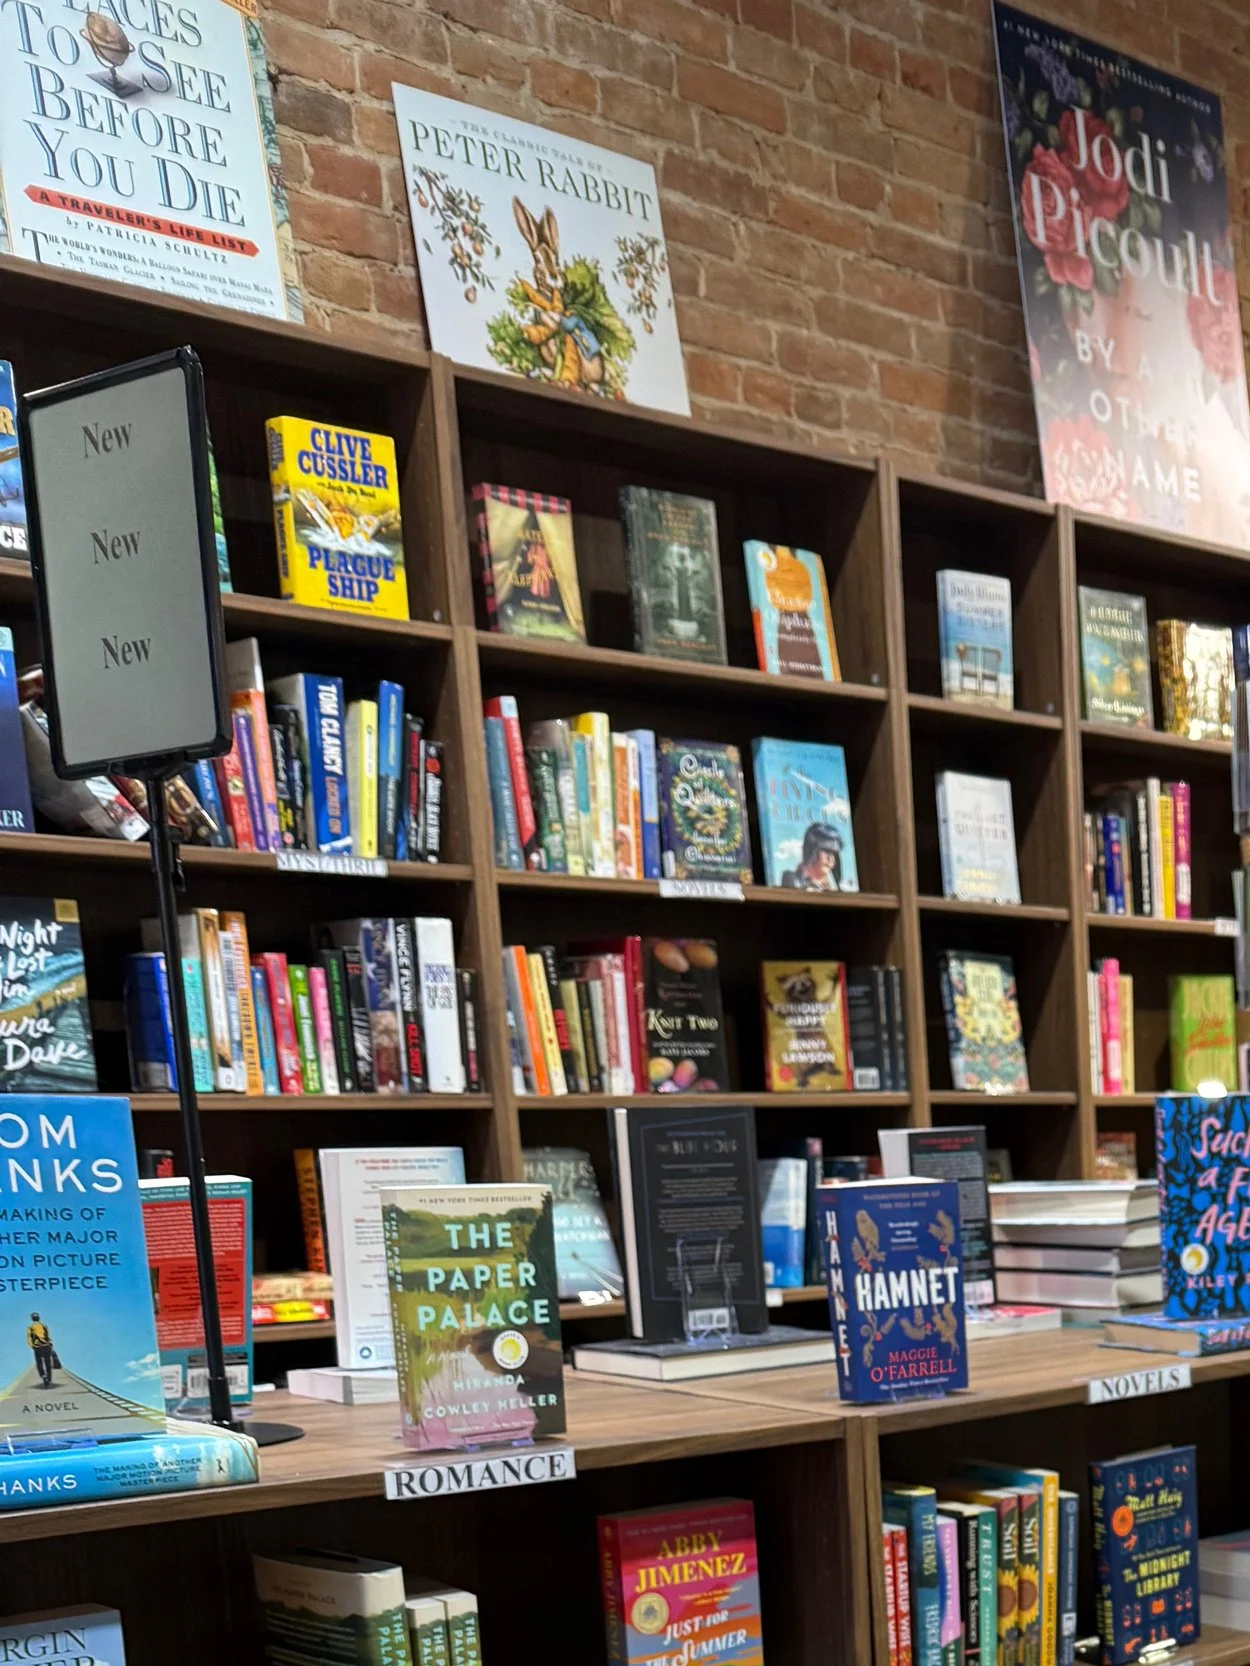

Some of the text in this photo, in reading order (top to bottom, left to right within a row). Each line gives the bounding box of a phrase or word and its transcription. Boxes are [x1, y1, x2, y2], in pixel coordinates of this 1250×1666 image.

[1, 0, 231, 113] TO SEE
[24, 61, 227, 167] BEFORE
[409, 119, 652, 222] PETER RABBIT
[1070, 104, 1172, 203] Jodi
[24, 119, 245, 227] YOU DIE
[39, 190, 247, 251] A TRAVELER'S LIFE LIST
[67, 217, 227, 264] by PATRICIA SCHULTZ
[1027, 171, 1224, 306] Picoult
[81, 421, 133, 459] New
[310, 428, 372, 462] CLIVE
[298, 450, 389, 490] CUSSLER
[92, 530, 141, 565] New
[307, 545, 395, 582] PLAGUE
[328, 573, 379, 602] SHIP
[101, 636, 151, 669] New
[0, 918, 63, 956] Night
[7, 949, 53, 981] Lost
[3, 1038, 88, 1071] Dave
[48, 1230, 118, 1245] MAJOR
[445, 1222, 513, 1250] THE
[34, 1253, 121, 1267] PICTURE
[427, 1261, 536, 1292] PAPER
[825, 1211, 851, 1376] HAMNET
[856, 1266, 959, 1312] HAMNET
[1187, 1273, 1235, 1290] KILEY
[417, 1298, 550, 1332] PALACE
[870, 1359, 957, 1382] O'FARRELL
[889, 1347, 938, 1364] MAGGIE
[454, 1374, 525, 1391] MIRANDA
[1101, 1368, 1180, 1399] NOVELS
[22, 1401, 80, 1413] A NOVEL
[424, 1394, 557, 1419] COWLEY HELLER
[392, 1453, 568, 1498] ROMANCE
[657, 1530, 723, 1560] ABBY
[981, 1522, 993, 1595] TRUST
[635, 1552, 747, 1594] JIMENEZ
[1138, 1551, 1191, 1577] MIDNIGHT
[1136, 1572, 1180, 1597] LIBRARY
[664, 1616, 701, 1645] JUST
